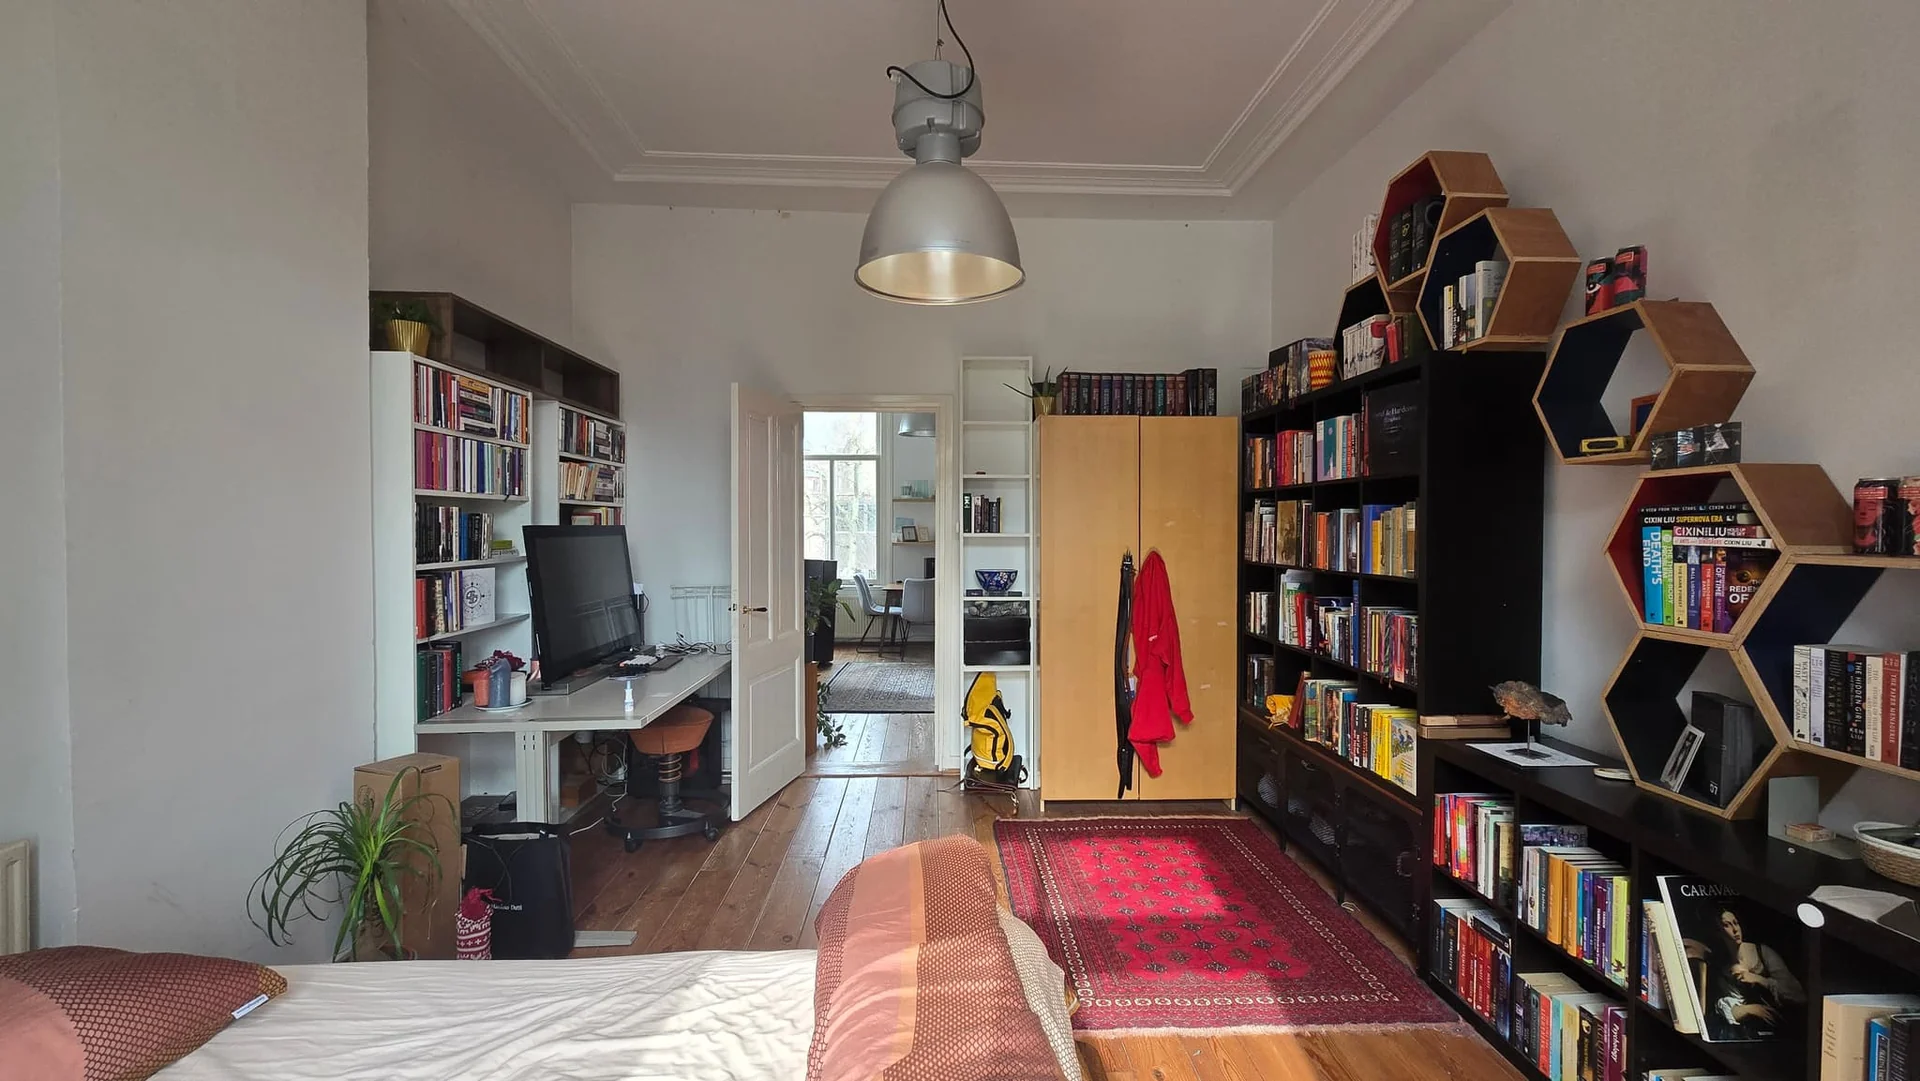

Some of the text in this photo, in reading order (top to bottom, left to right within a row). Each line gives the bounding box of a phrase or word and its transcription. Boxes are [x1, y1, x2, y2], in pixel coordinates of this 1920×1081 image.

[1644, 516, 1662, 524] CIXIN
[1664, 516, 1676, 524] LIU
[1675, 527, 1726, 537] CIXIN LIU
[1642, 540, 1650, 567] END
[1650, 532, 1662, 585] DEATH'S
[1716, 568, 1722, 578] OF
[1729, 593, 1750, 604] OF
[1794, 699, 1802, 720] QIUFAN
[1612, 1024, 1620, 1064] Psychology
